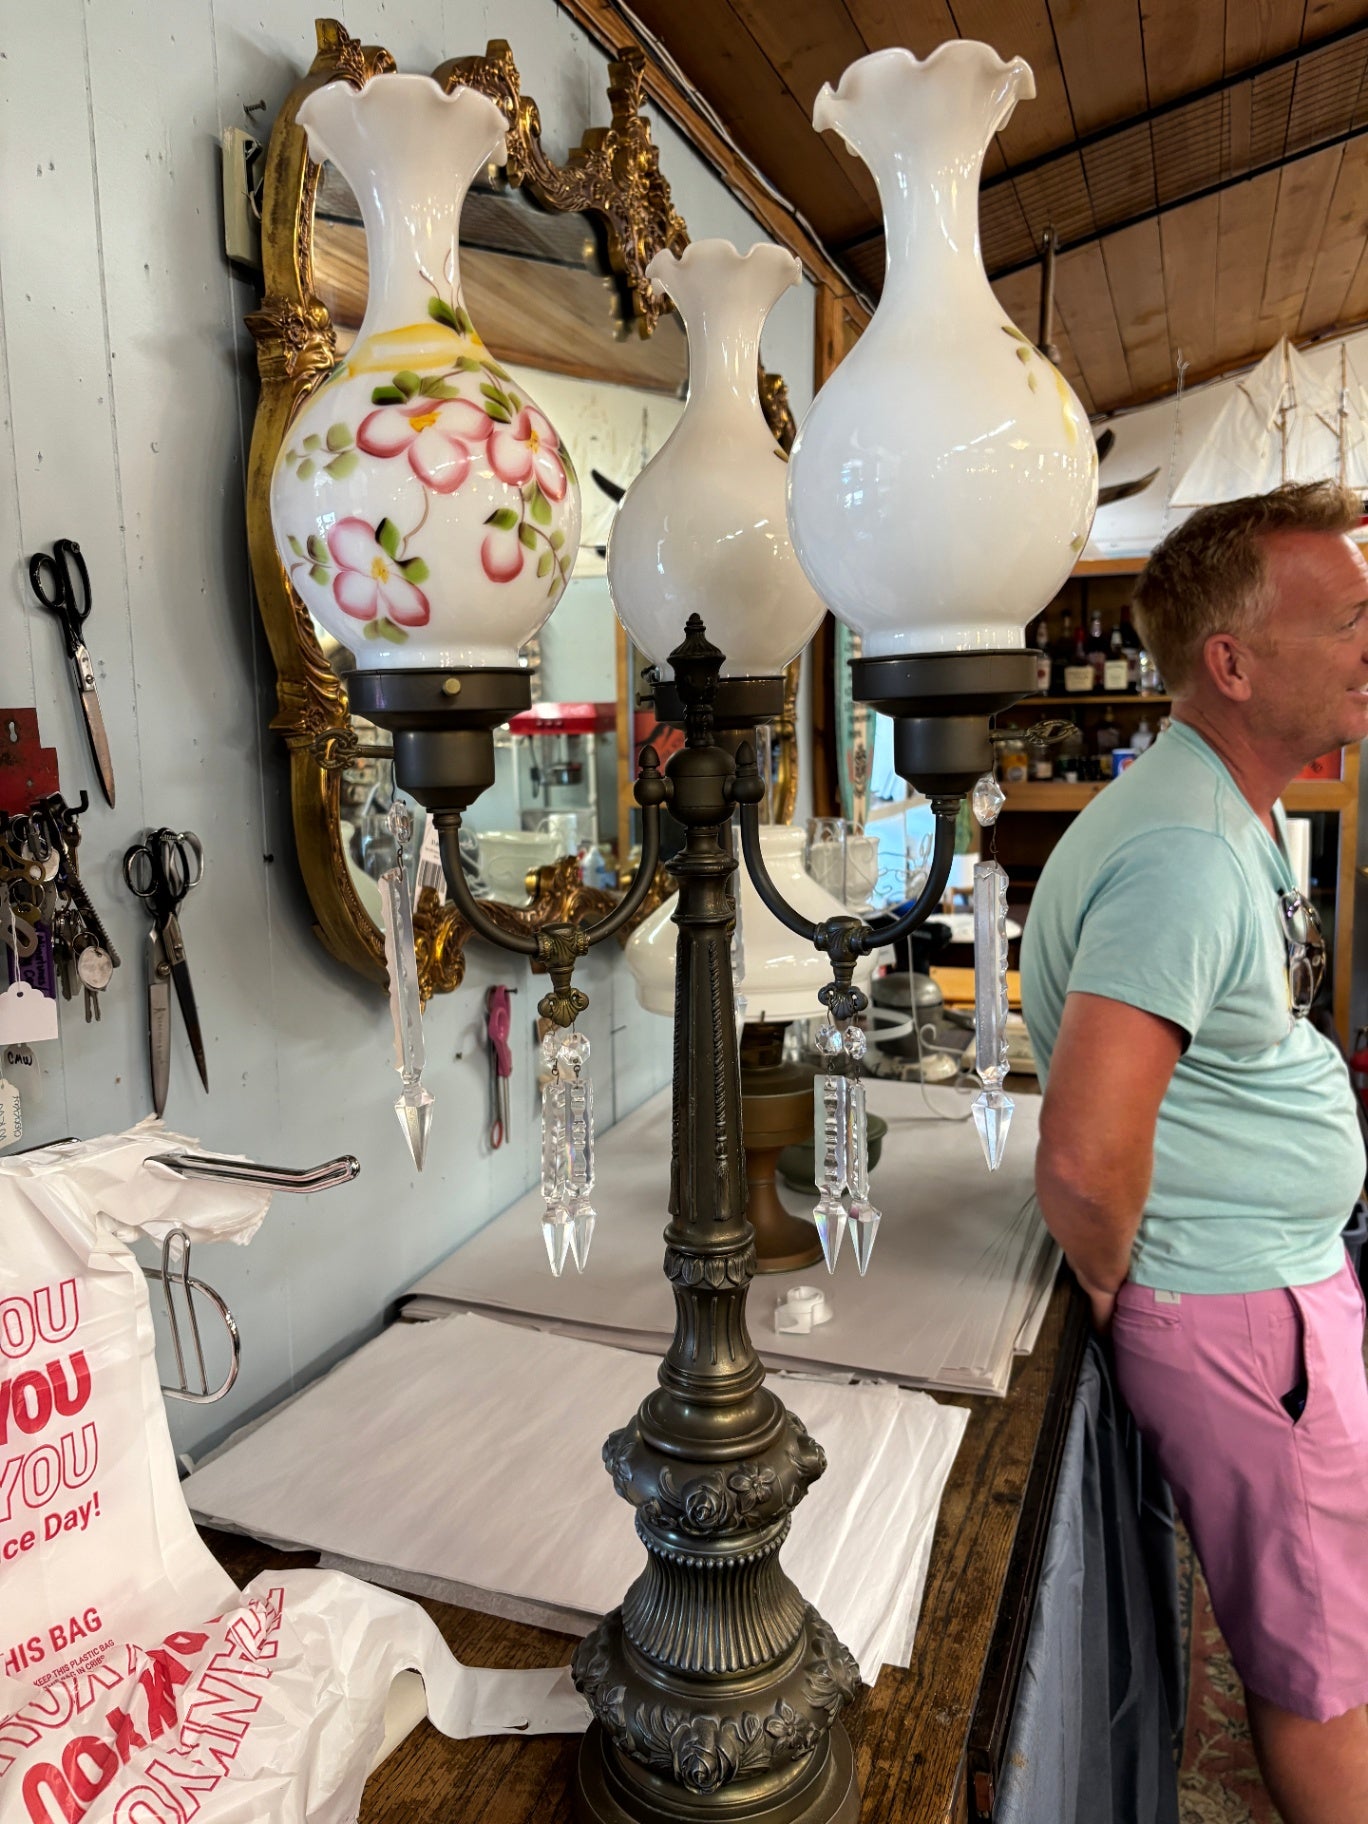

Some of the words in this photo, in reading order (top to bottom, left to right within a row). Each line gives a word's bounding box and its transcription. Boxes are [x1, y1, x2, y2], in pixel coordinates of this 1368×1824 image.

[0, 1530, 36, 1563] ce
[44, 1490, 101, 1541] Day!
[0, 1636, 45, 1677] HIS
[48, 1606, 103, 1652] BAG
[33, 1673, 52, 1687] KEEP
[52, 1663, 70, 1678] THIS
[69, 1647, 100, 1669] PLASTIC
[98, 1639, 115, 1652] BAG
[76, 1666, 86, 1676] IN
